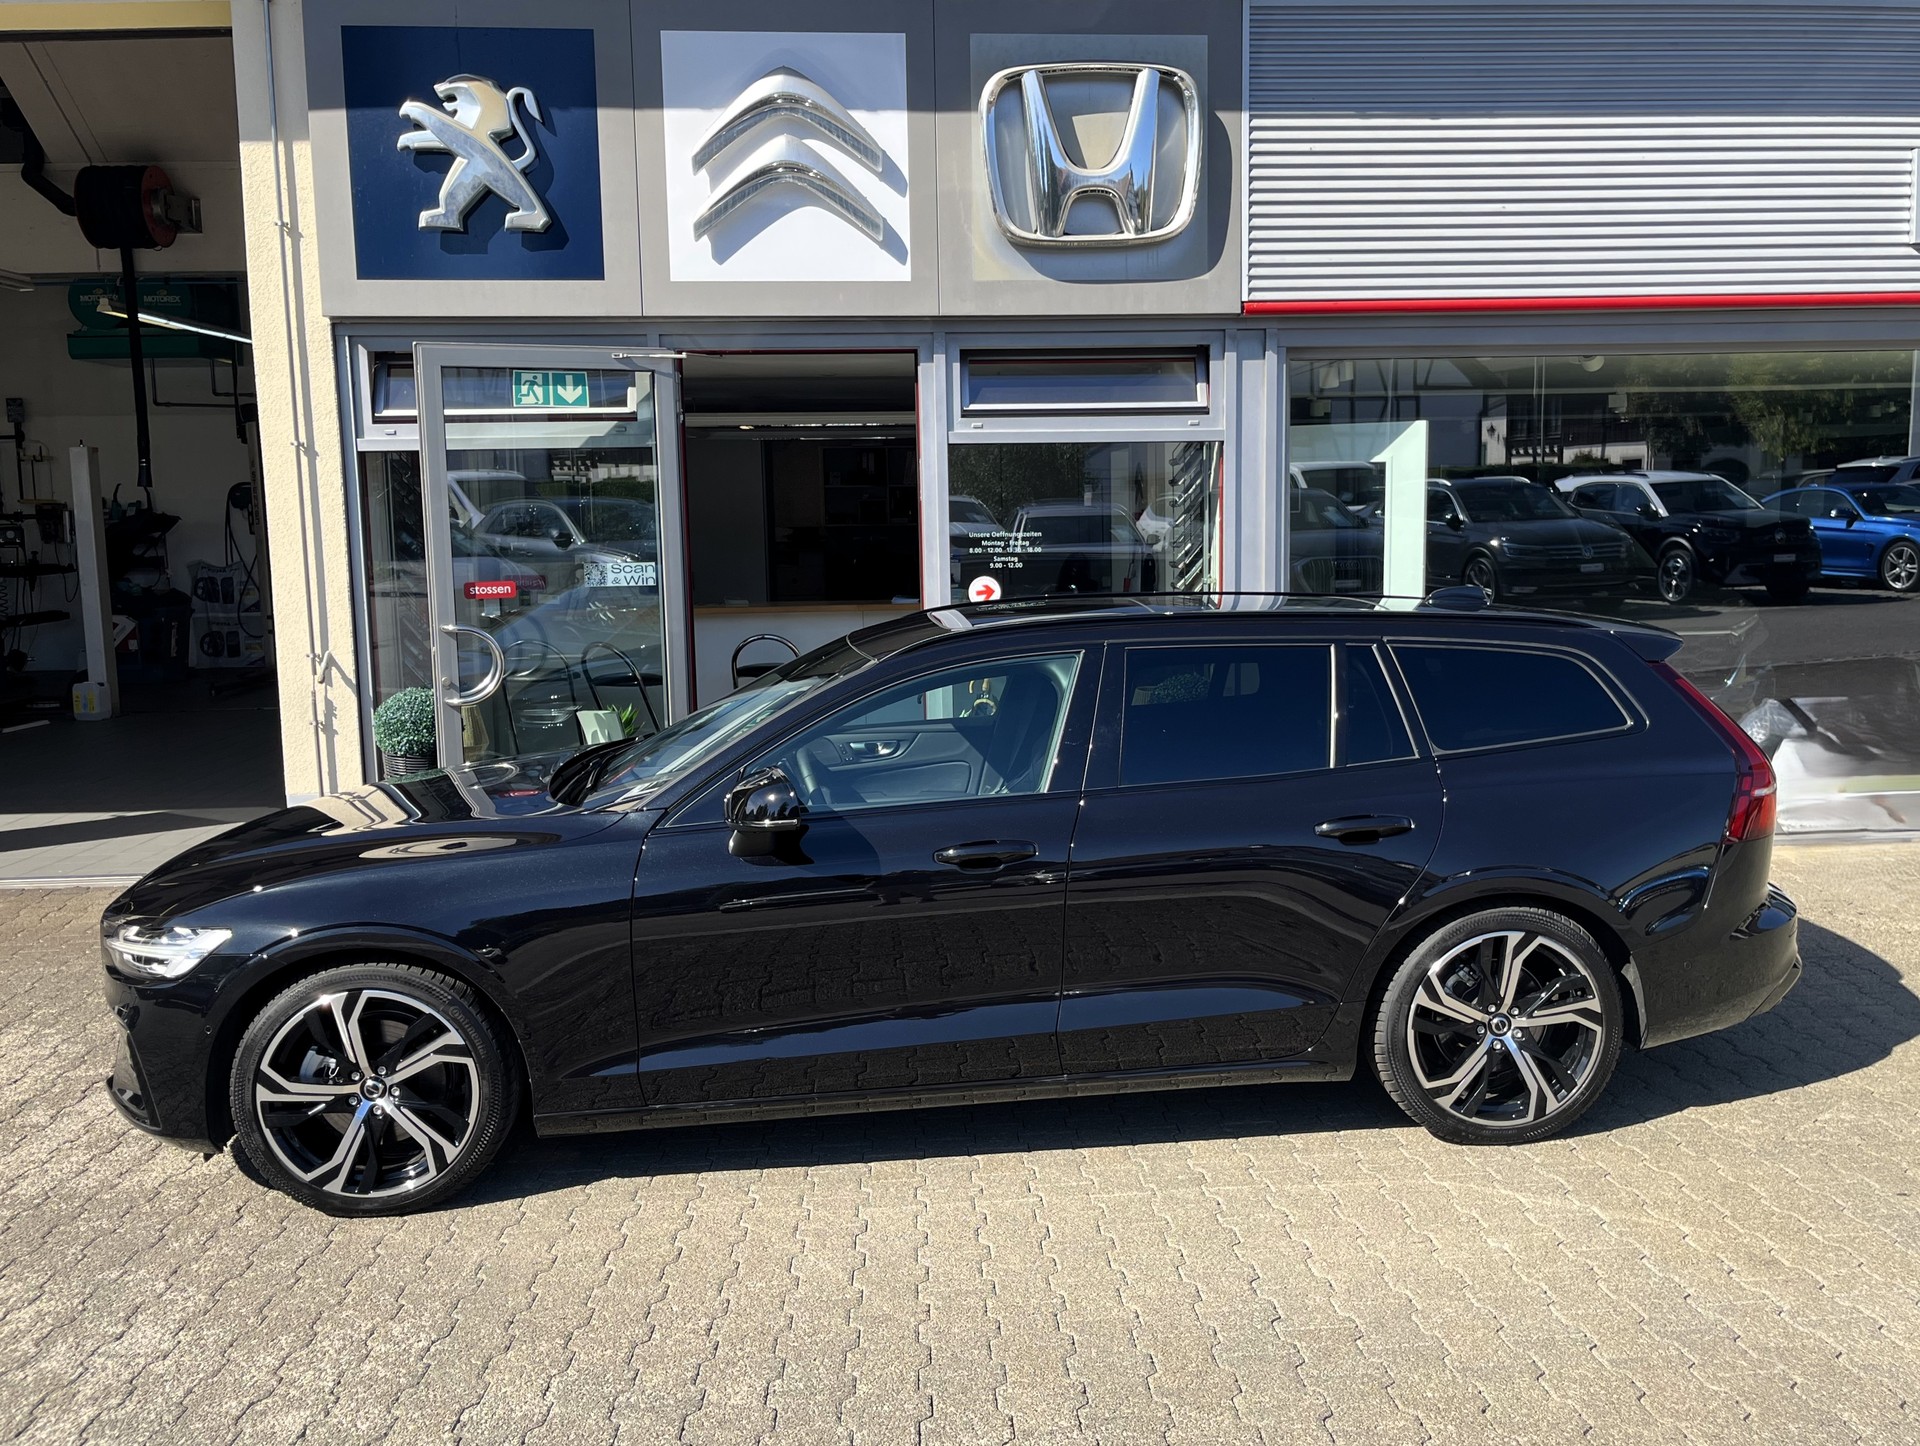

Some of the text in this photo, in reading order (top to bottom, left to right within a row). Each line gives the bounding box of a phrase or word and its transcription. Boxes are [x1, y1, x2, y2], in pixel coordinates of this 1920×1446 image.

[143, 295, 181, 303] MOTOREX
[991, 531, 1042, 539] Oeffnungszeiten
[1009, 539, 1030, 547] Freitag
[610, 563, 656, 575] Scan
[611, 574, 656, 586] & Win
[469, 585, 511, 595] stossen
